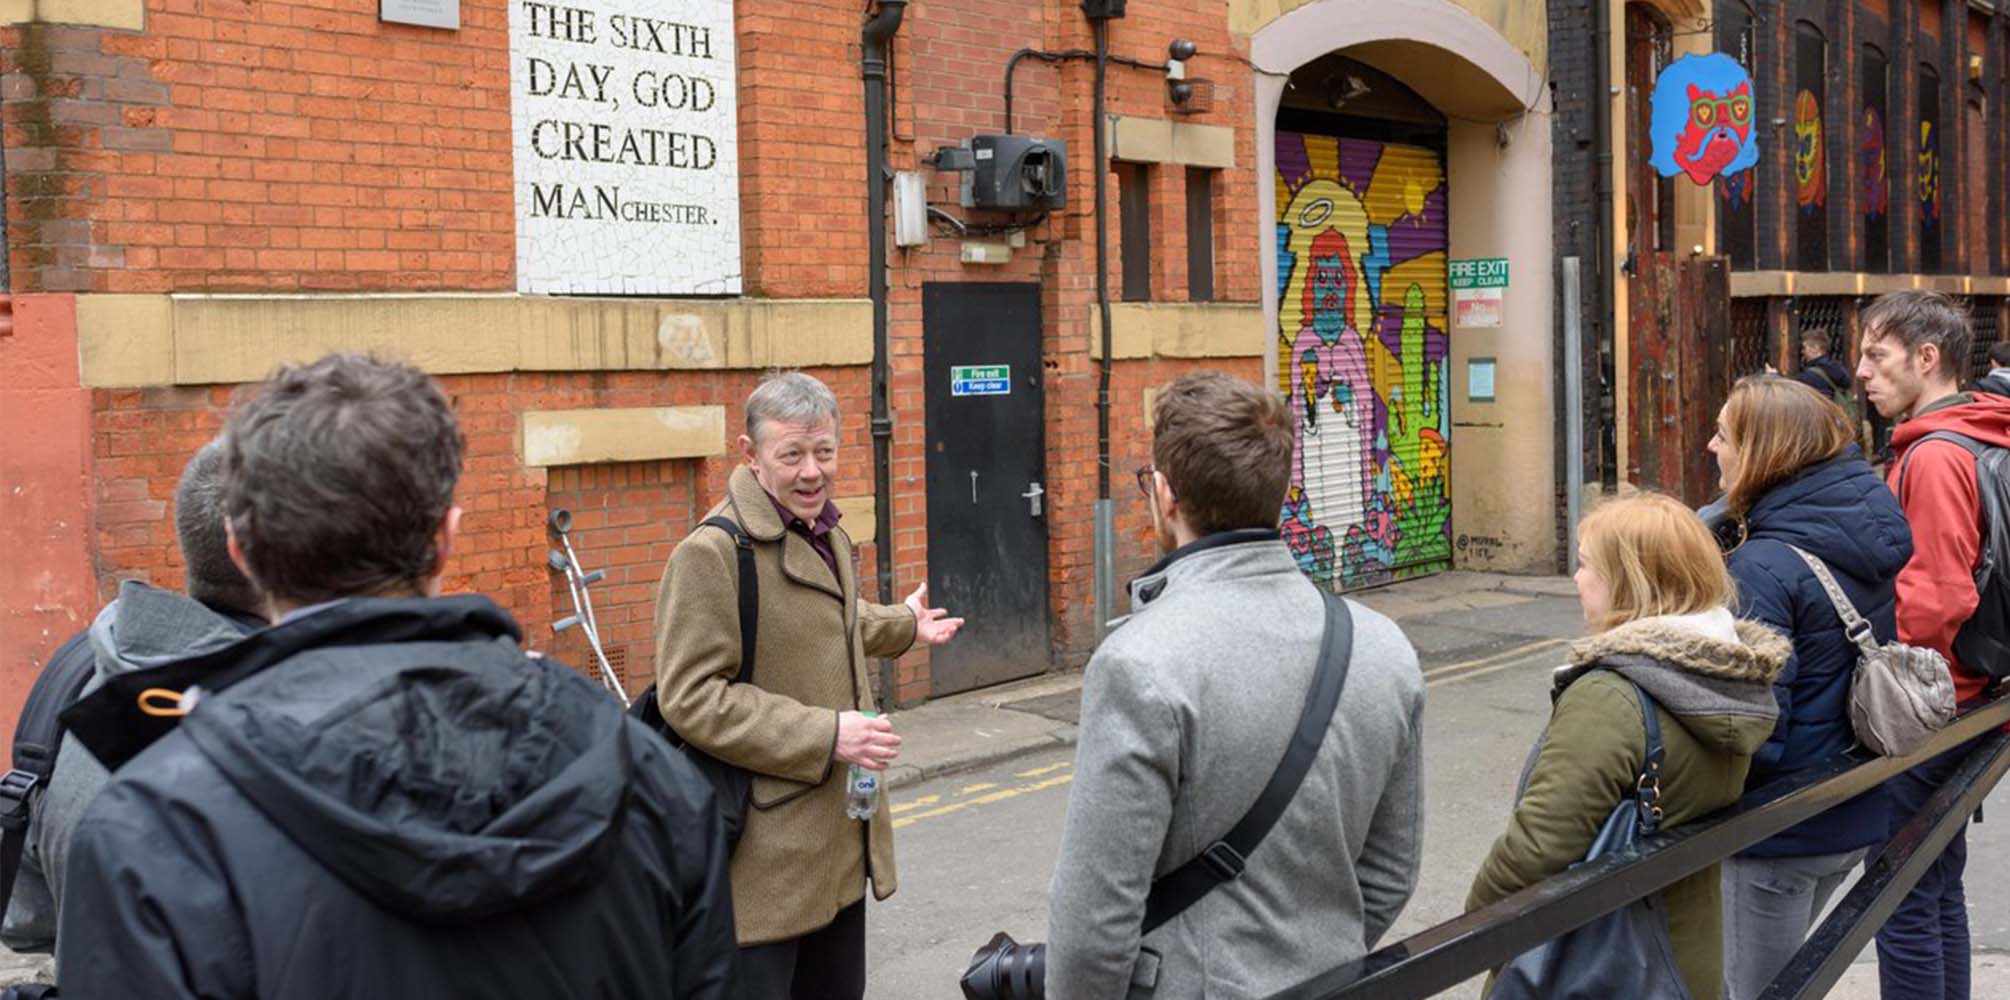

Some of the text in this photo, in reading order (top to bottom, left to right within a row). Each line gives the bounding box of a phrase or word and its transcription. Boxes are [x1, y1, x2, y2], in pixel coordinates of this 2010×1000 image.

[523, 2, 713, 59] THE SIXTH
[526, 57, 715, 112] DAY, GOD
[531, 119, 717, 171] CREATED
[1449, 261, 1508, 277] FIRE EXIT
[1453, 277, 1505, 287] KEEP CLEAR
[971, 368, 999, 379] Fire exit
[969, 381, 1002, 392] Keep clear
